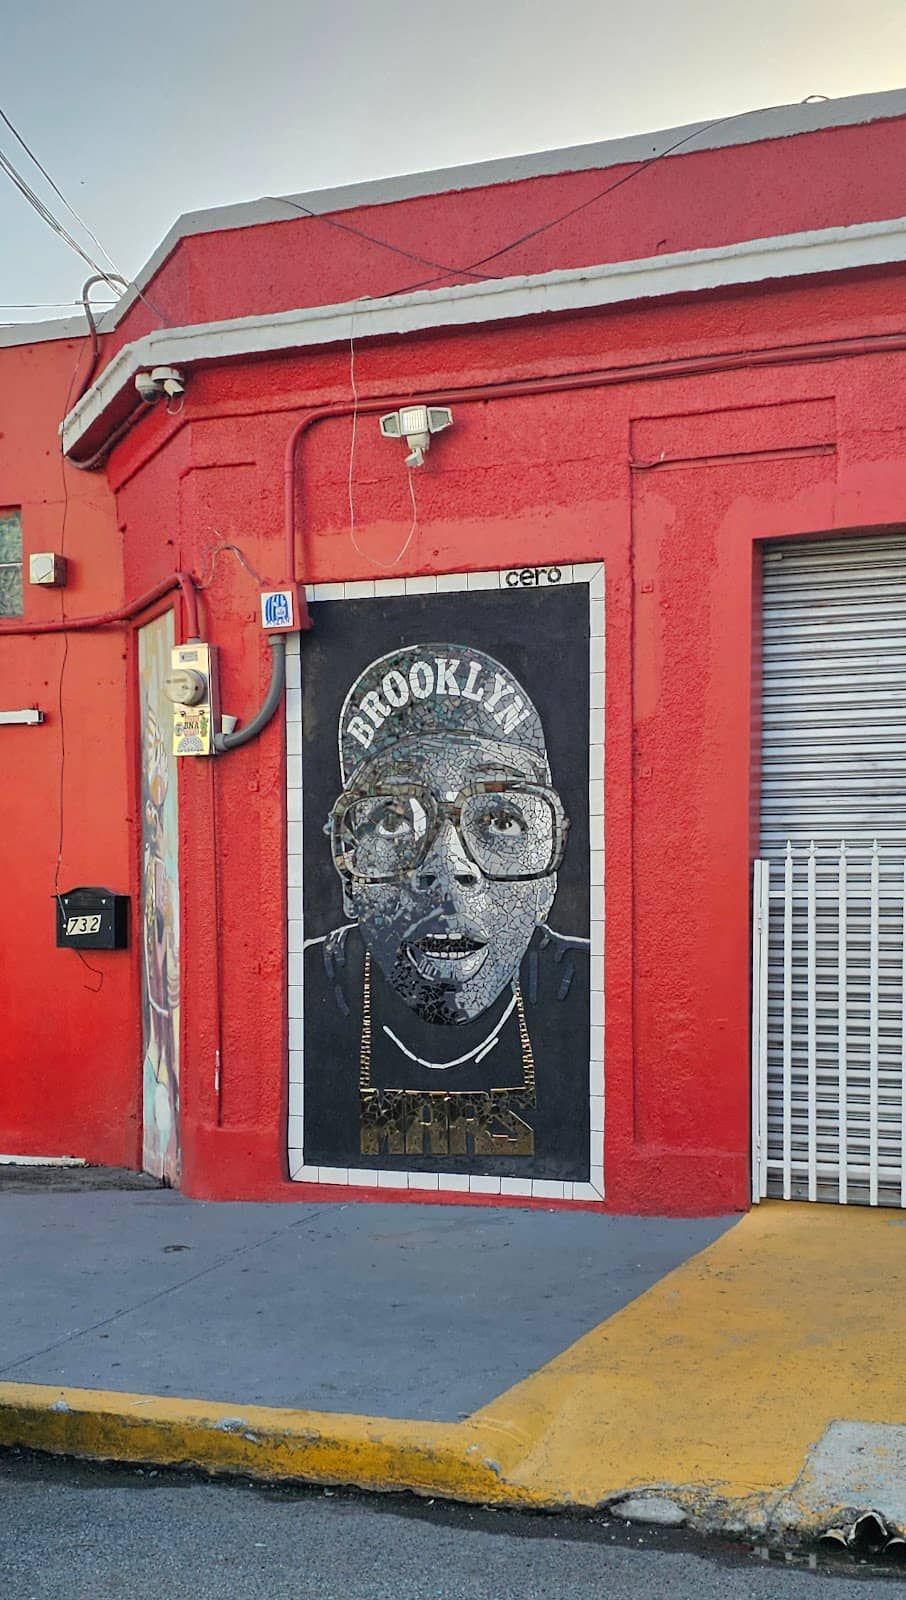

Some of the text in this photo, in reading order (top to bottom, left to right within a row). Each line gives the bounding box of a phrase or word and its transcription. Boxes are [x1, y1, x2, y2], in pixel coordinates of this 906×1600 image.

[506, 567, 562, 587] cero
[347, 658, 530, 749] BROOKLYN
[69, 917, 99, 933] 732
[360, 1087, 536, 1156] MARS
